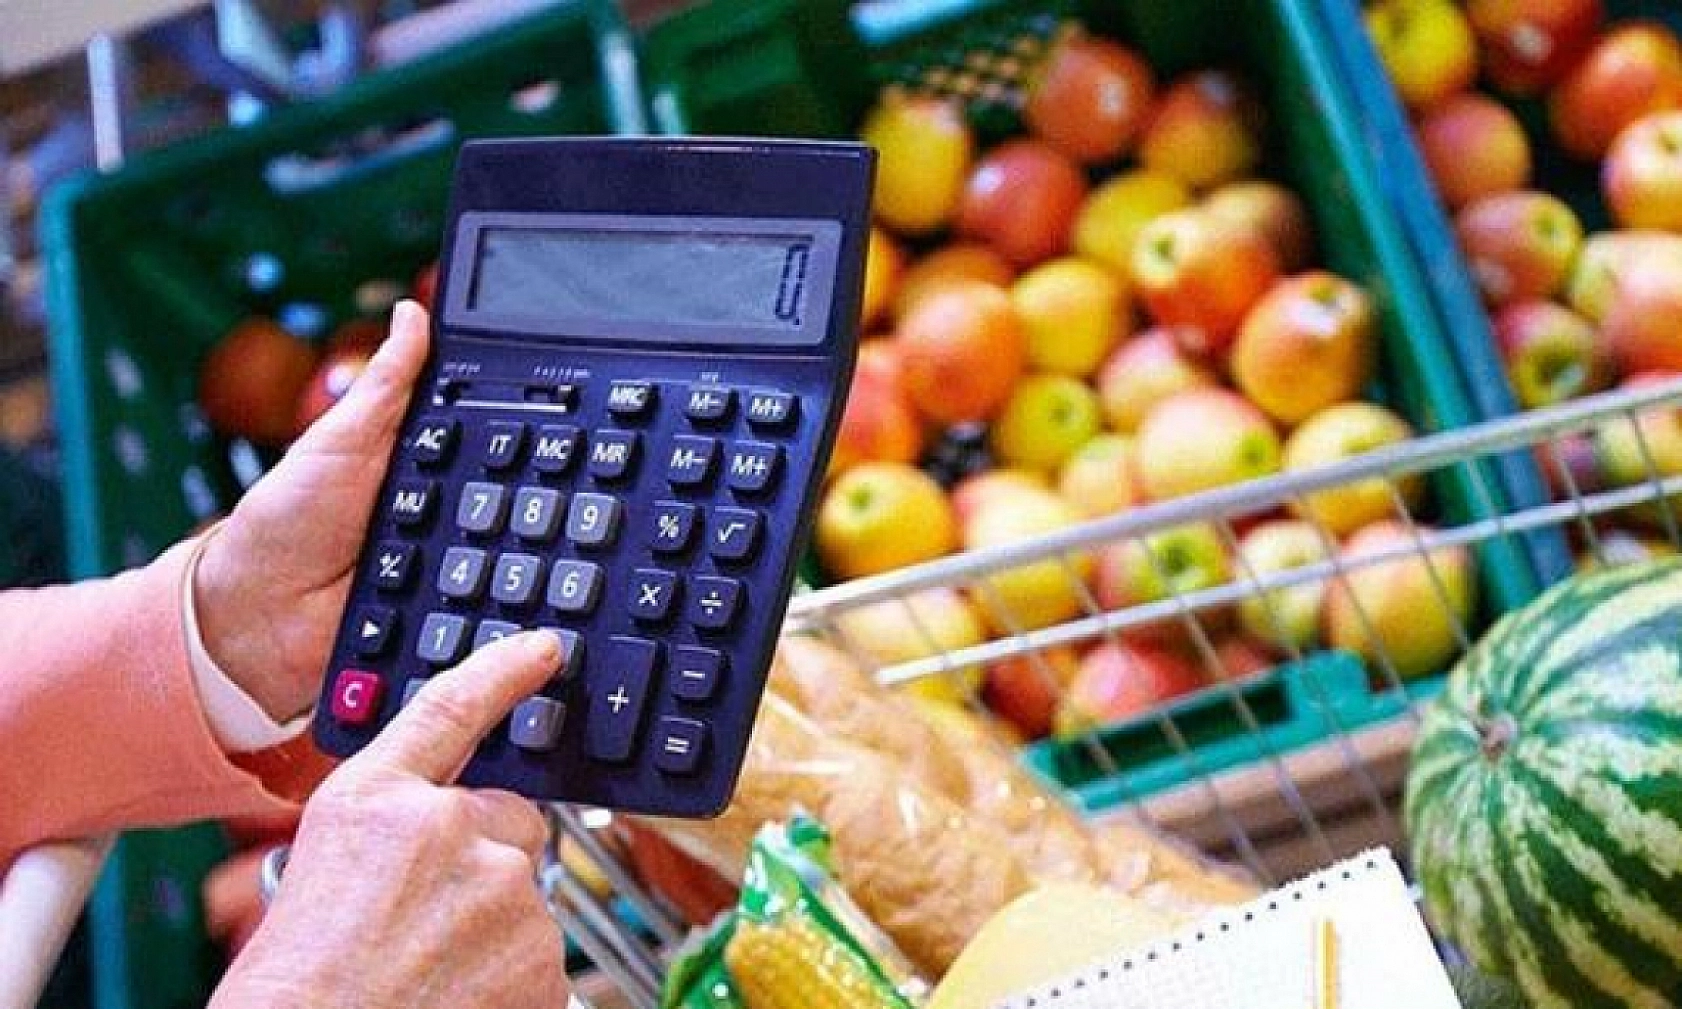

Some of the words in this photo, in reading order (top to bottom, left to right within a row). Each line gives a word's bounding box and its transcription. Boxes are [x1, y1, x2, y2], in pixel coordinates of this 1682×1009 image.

[416, 428, 447, 451] AC
[536, 437, 572, 460] MC
[590, 442, 628, 463] MR
[731, 453, 767, 476] M+
[393, 489, 428, 513] MU
[471, 495, 488, 520] 7
[523, 497, 542, 524] 8
[580, 505, 599, 531] 9
[658, 513, 679, 538] %
[449, 558, 470, 585] 4
[505, 565, 523, 591] 5
[562, 570, 580, 598] 6
[434, 626, 448, 651] 1
[341, 683, 364, 709] C
